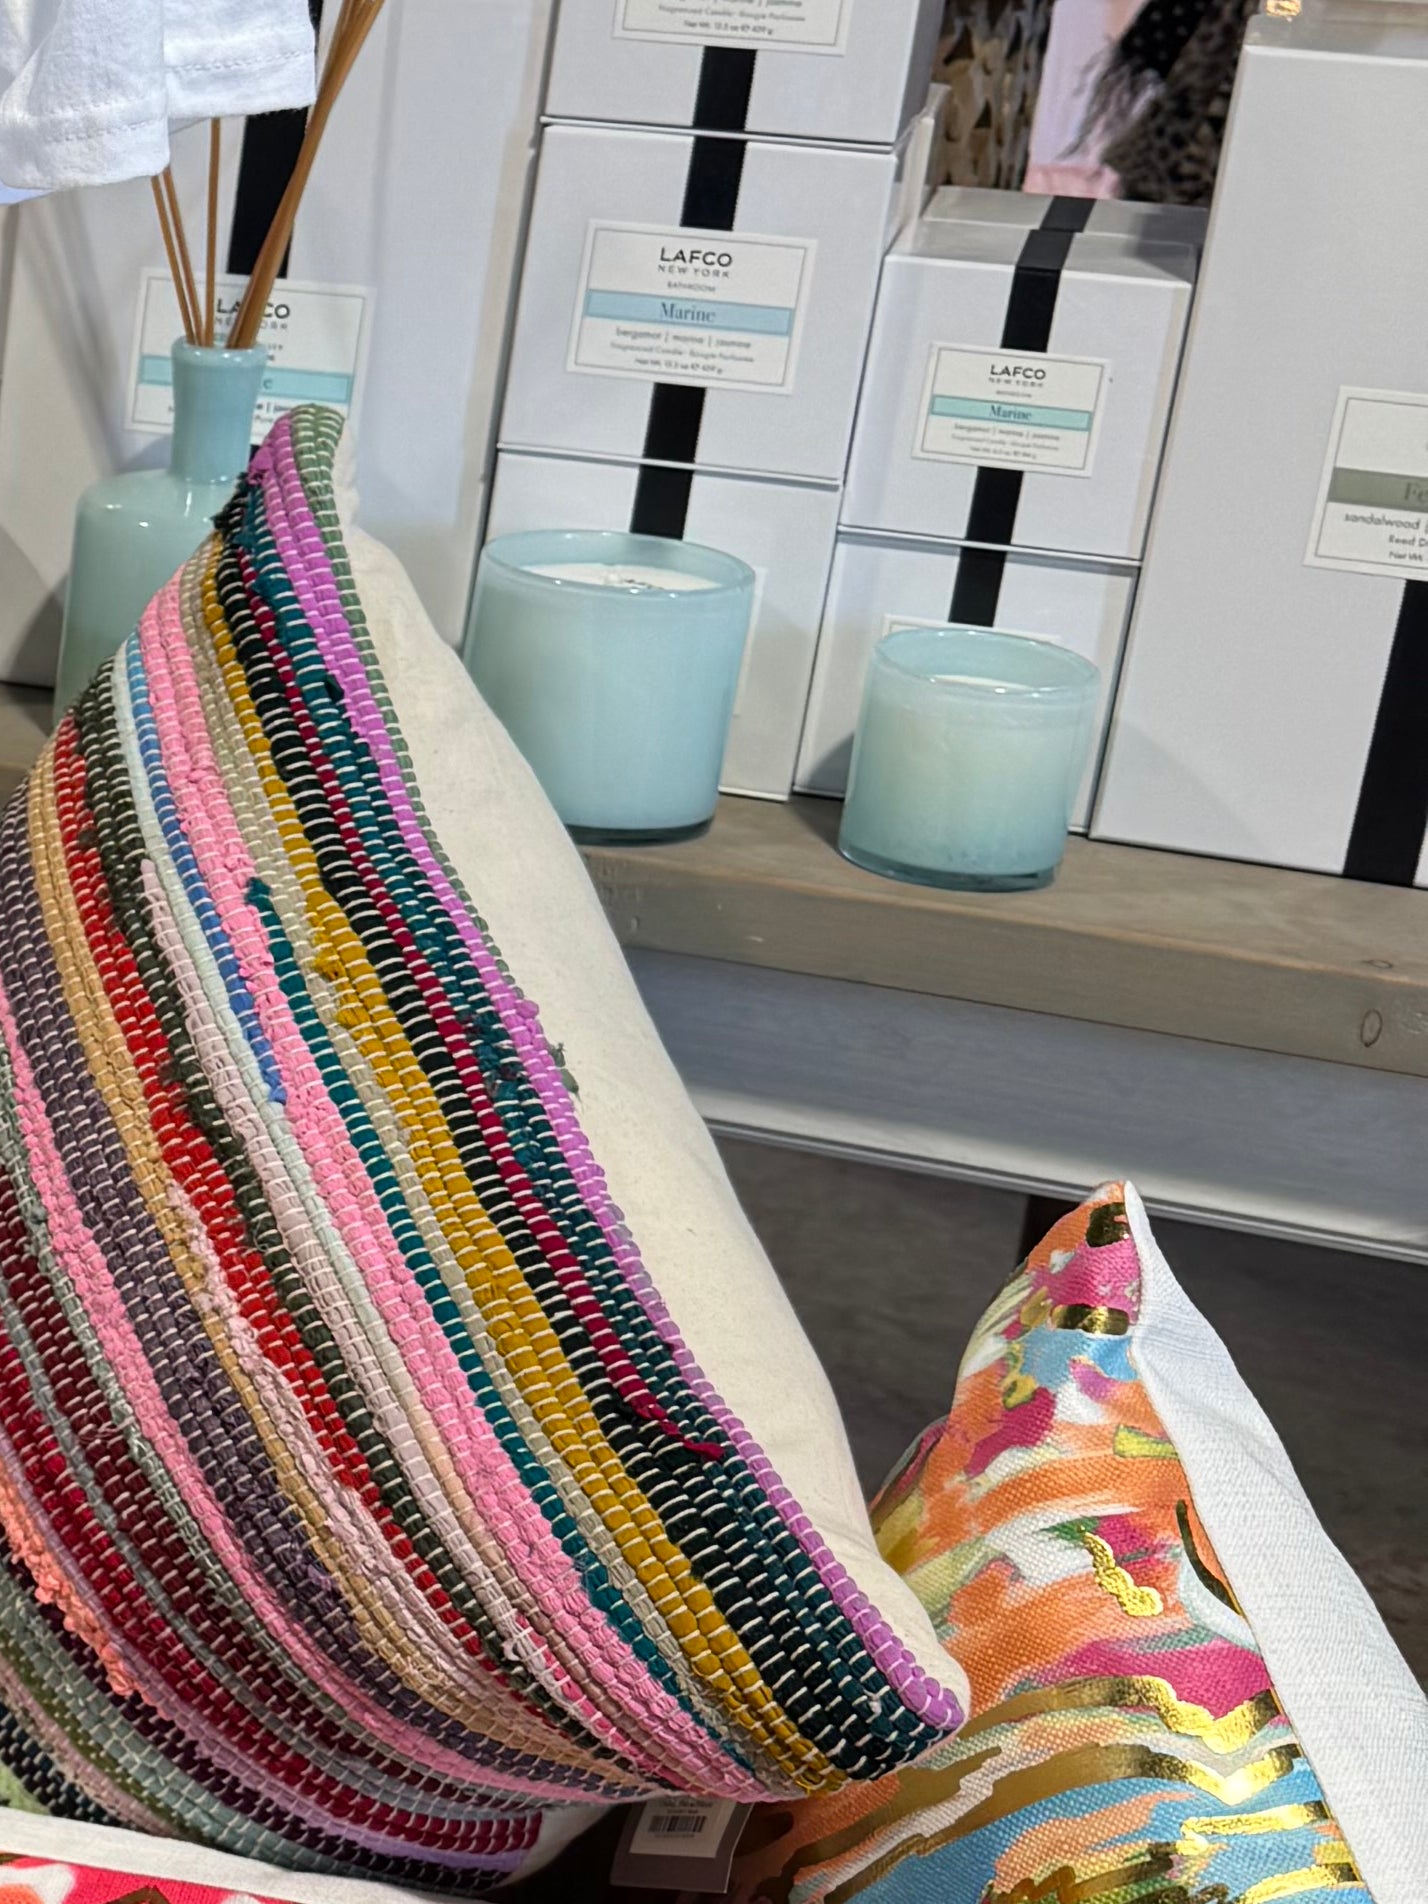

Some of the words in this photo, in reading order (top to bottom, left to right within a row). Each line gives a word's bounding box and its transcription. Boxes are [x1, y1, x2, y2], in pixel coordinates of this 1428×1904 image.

[659, 246, 733, 267] LAFCO
[657, 264, 689, 274] NEW
[216, 298, 290, 319] LACO
[660, 301, 716, 323] Marine
[990, 364, 1046, 381] LAFCO
[1343, 512, 1421, 531] sandalwood
